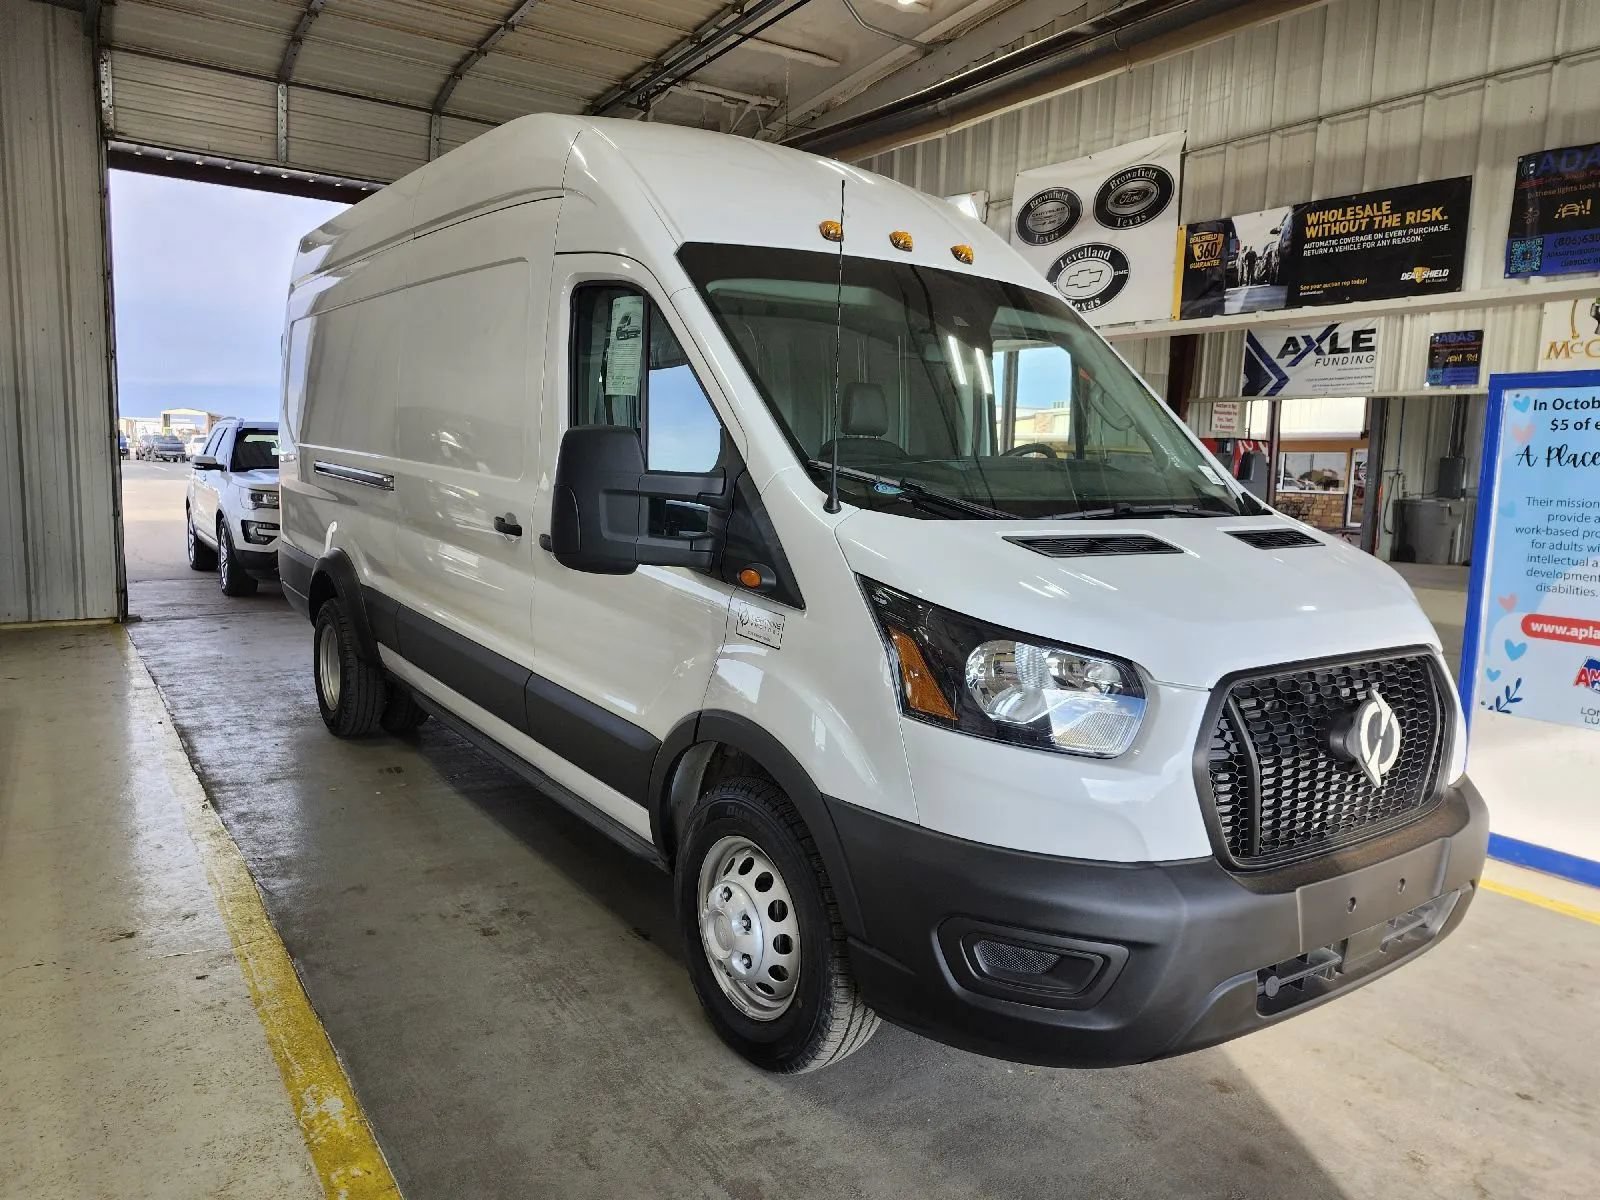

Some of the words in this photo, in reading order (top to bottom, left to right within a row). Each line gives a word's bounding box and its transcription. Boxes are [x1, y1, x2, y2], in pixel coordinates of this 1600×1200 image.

[1109, 167, 1158, 190] Brownfield
[1029, 189, 1069, 209] Brownfield
[1116, 212, 1147, 227] Texas
[1306, 200, 1392, 226] WHOLESALE
[1305, 217, 1371, 239] WITHOUT
[1373, 212, 1402, 230] THE
[1406, 206, 1449, 225] RISK.
[1035, 231, 1060, 244] Texas
[1303, 238, 1339, 250] AUTOMATIC
[1339, 233, 1373, 246] COVERAGE
[1373, 232, 1384, 240] ON
[1384, 229, 1407, 239] EVERY
[1408, 223, 1452, 236] PURCHASE.
[1303, 246, 1329, 257] RETURN
[1329, 246, 1334, 254] A
[1335, 243, 1361, 254] VEHICLE
[1362, 241, 1376, 250] FOR
[1376, 239, 1391, 248] ANY
[1059, 247, 1112, 269] Levelland
[1190, 259, 1221, 270] GUARANTEE
[1300, 283, 1310, 291] See
[1310, 282, 1323, 291] your
[1322, 280, 1341, 289] auction
[1341, 279, 1351, 288] rep
[1276, 322, 1377, 367] AXLE
[1314, 354, 1375, 367] FUNDING
[1533, 398, 1548, 411] In
[1552, 396, 1600, 411] Octob
[1550, 417, 1569, 432] $5
[1573, 417, 1592, 431] of
[1515, 444, 1538, 468] A
[1545, 443, 1600, 468] Place
[1525, 495, 1553, 507] Their
[1556, 498, 1600, 509] mission
[1547, 512, 1591, 524] provide
[1515, 524, 1580, 538] work-based
[1530, 538, 1547, 549] for
[1548, 540, 1584, 553] adults
[1527, 552, 1589, 567] intellectual
[1535, 582, 1599, 598] disabilities.
[1530, 622, 1600, 641] www.apla
